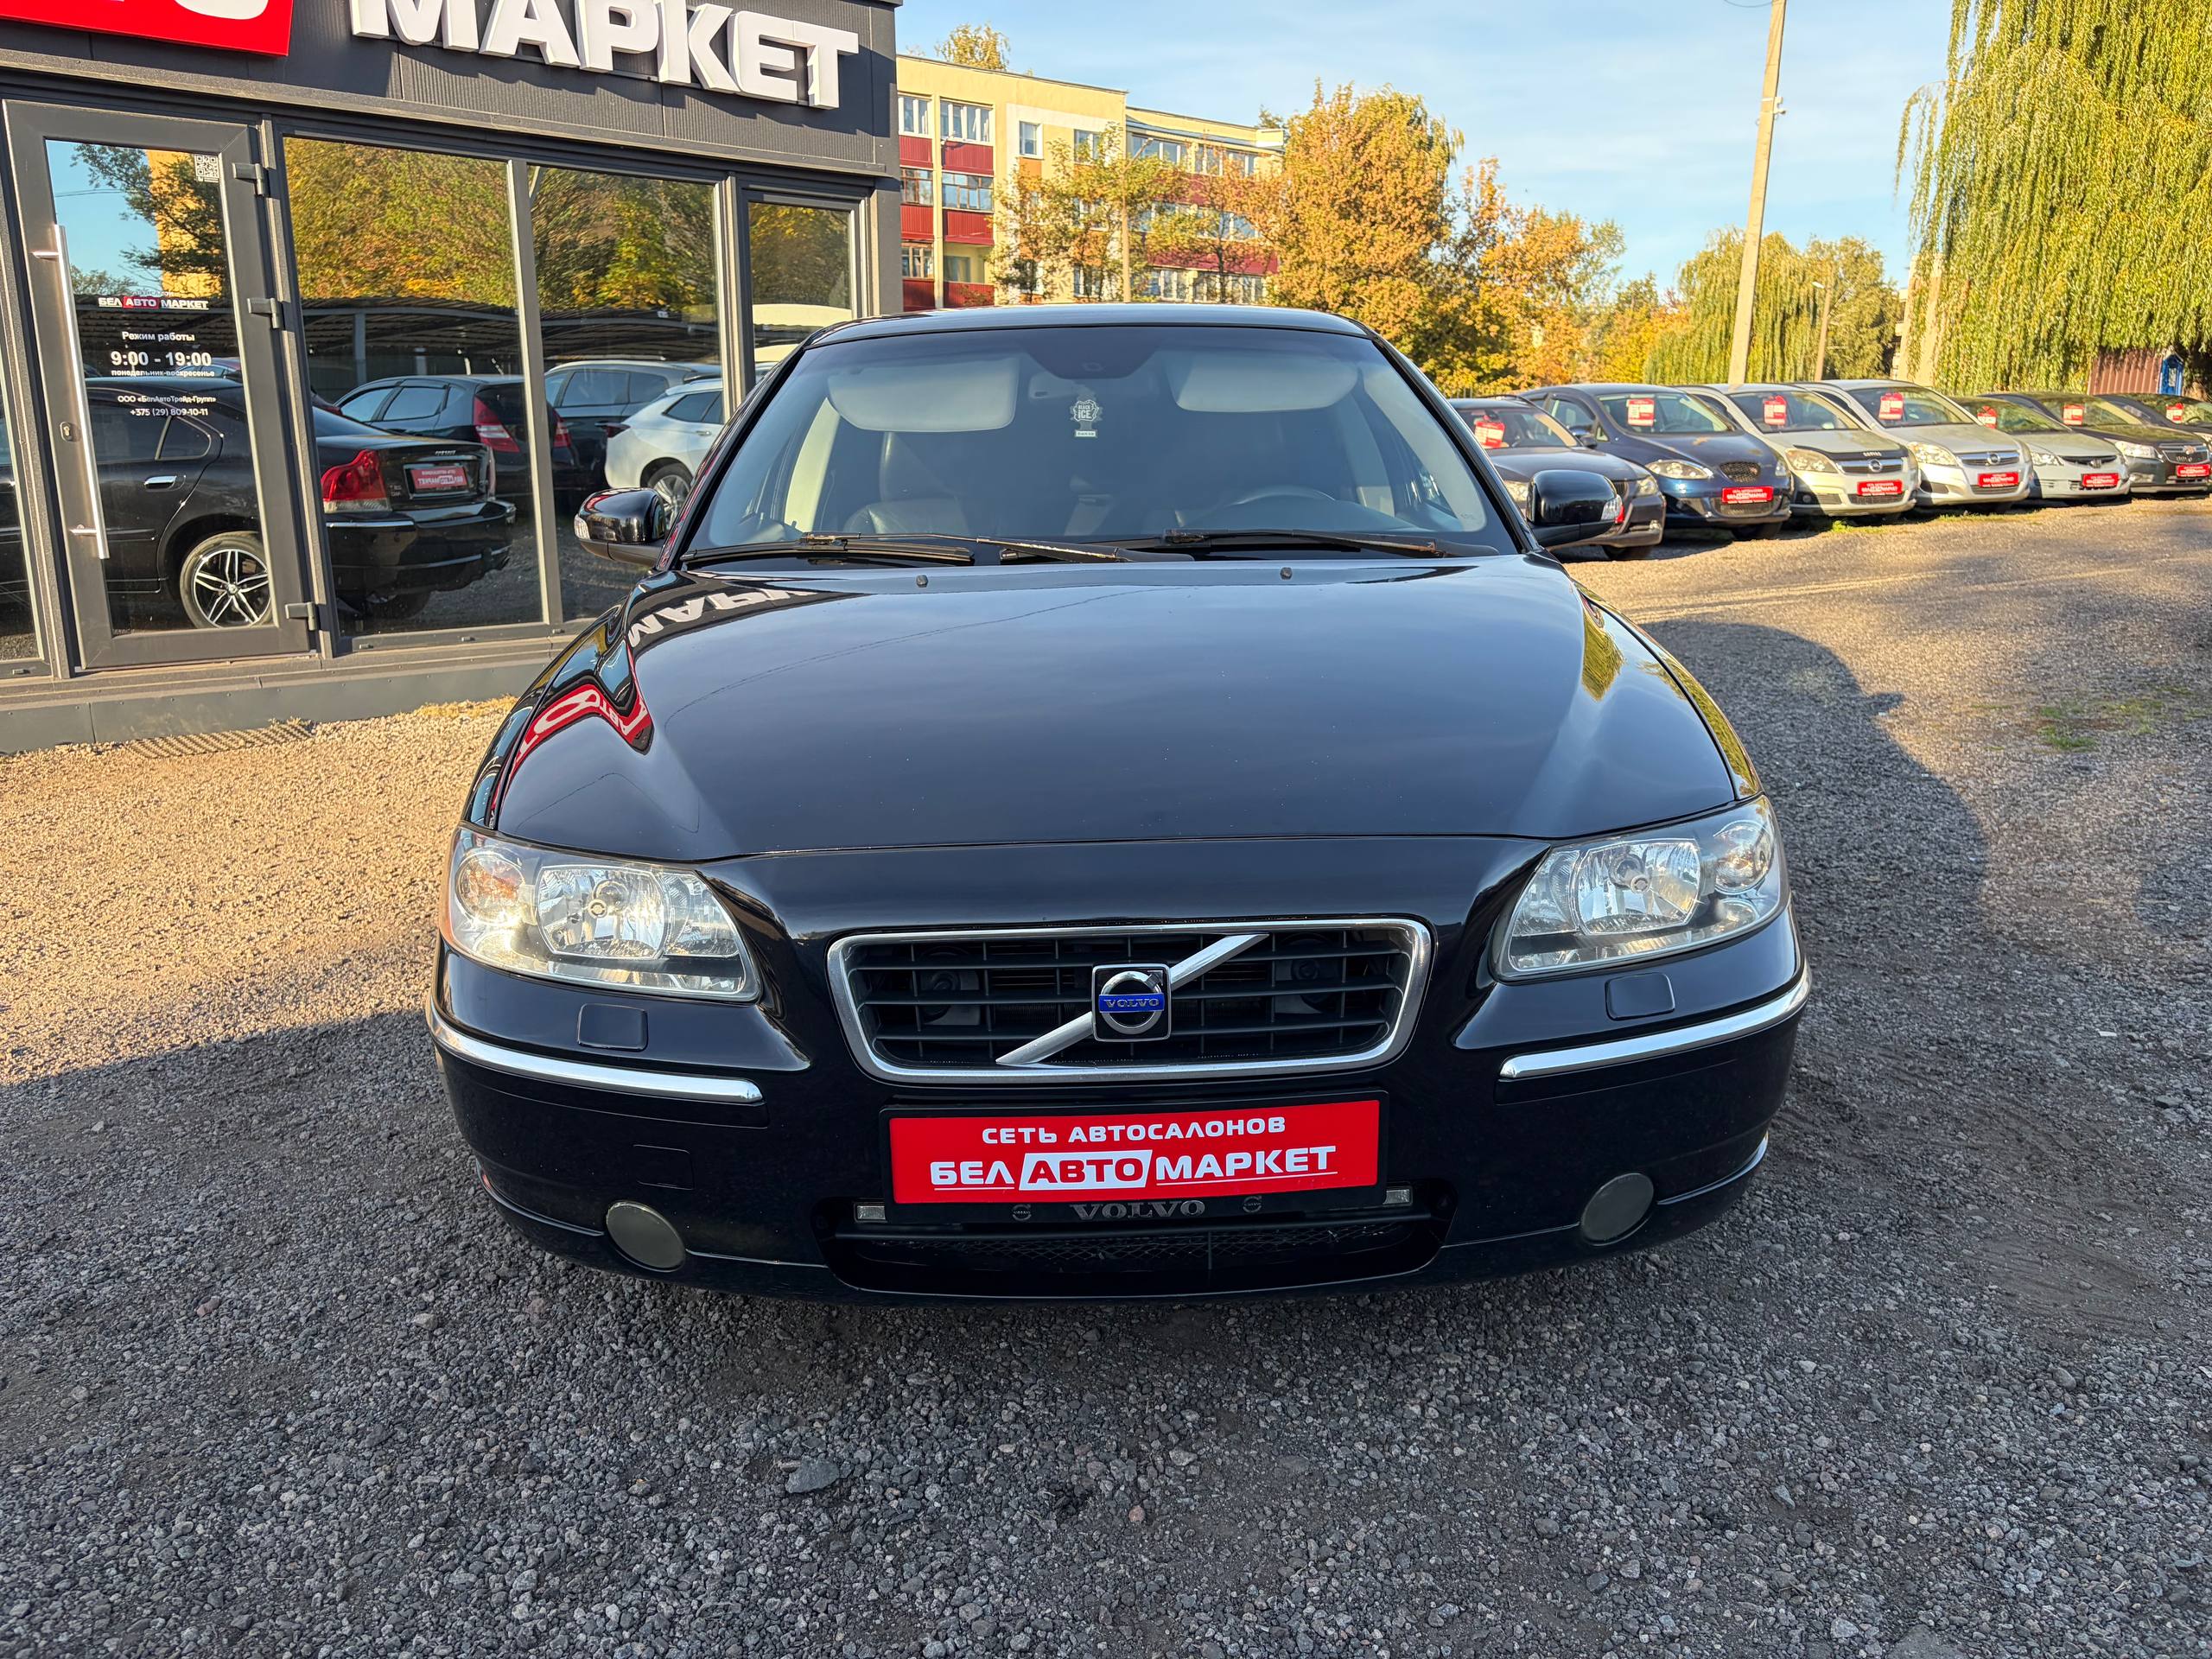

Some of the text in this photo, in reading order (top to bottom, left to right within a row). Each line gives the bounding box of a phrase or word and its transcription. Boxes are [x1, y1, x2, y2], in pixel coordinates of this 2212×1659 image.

[98, 297, 209, 308] БЕЛ АВТО МАРКЕТ
[122, 331, 195, 342] Режим работы
[111, 351, 149, 366] 9:00
[165, 352, 213, 366] 19:00
[152, 408, 168, 416] (29)
[1103, 998, 1160, 1008] VOLVO
[982, 1116, 1286, 1145] СЕТЬ АВТОСАЛОНОВ
[930, 1145, 1337, 1185] БЕЛ АВТО МАРКЕТ
[1070, 1199, 1206, 1221] VOLVO
